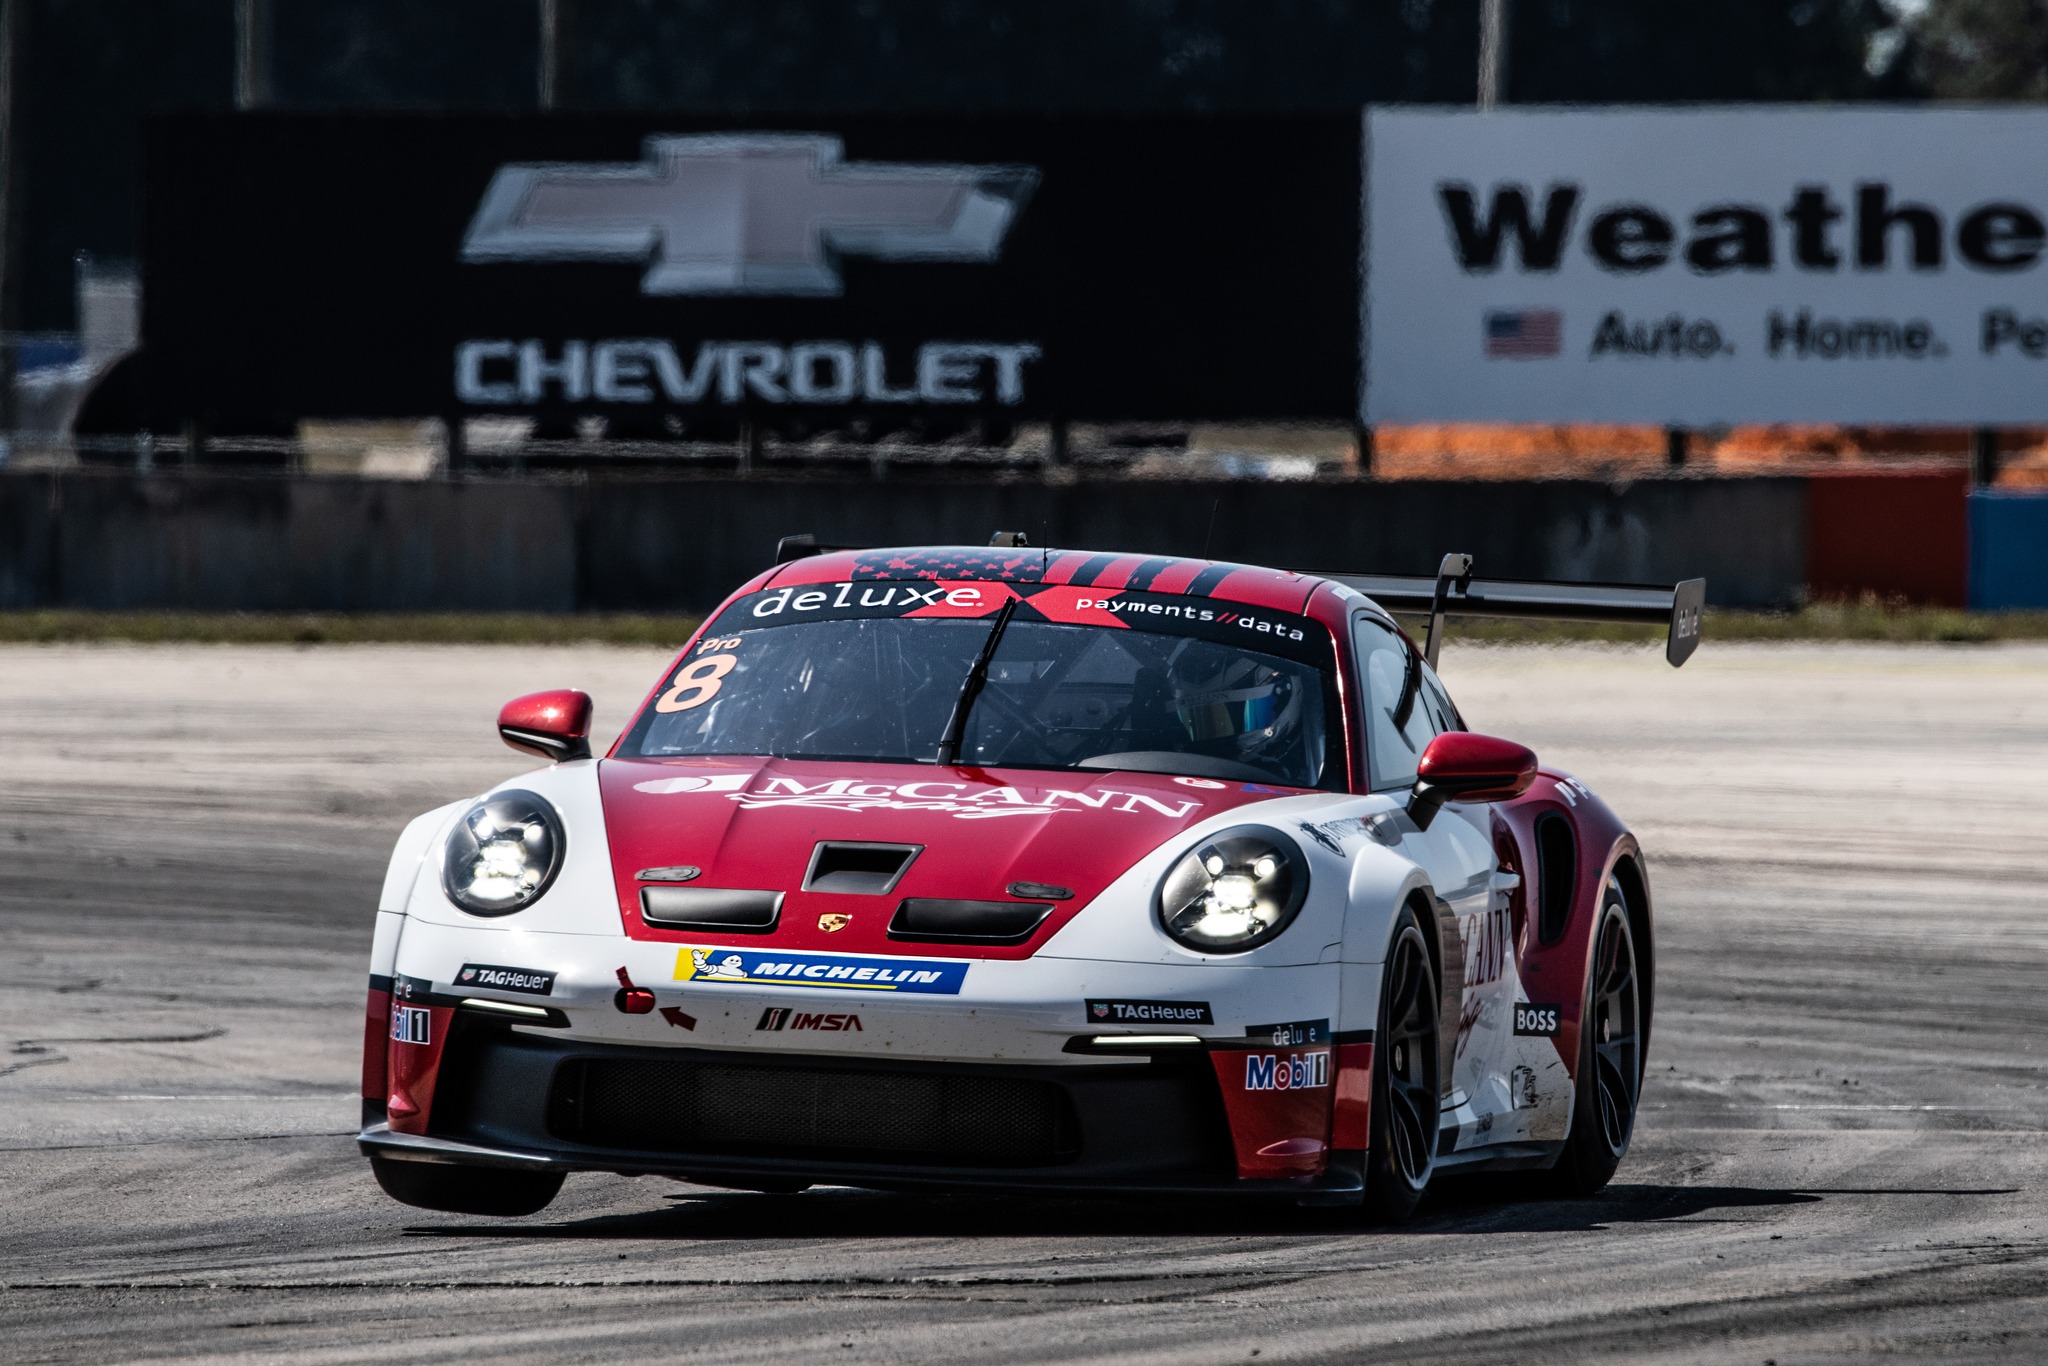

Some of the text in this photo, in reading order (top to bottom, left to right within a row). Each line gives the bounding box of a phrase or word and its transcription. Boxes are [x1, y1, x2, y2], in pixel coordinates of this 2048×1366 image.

[1436, 179, 2048, 277] Weathe
[1592, 306, 2048, 360] Auto. Home. Pe
[455, 338, 1043, 406] CHEVROLET
[655, 654, 737, 713] 8
[755, 777, 1203, 818] McCANN
[753, 962, 943, 984] MICHELIN
[790, 1013, 863, 1032] IMSA
[1272, 1024, 1316, 1046] delue
[1517, 1010, 1557, 1031] BOSS
